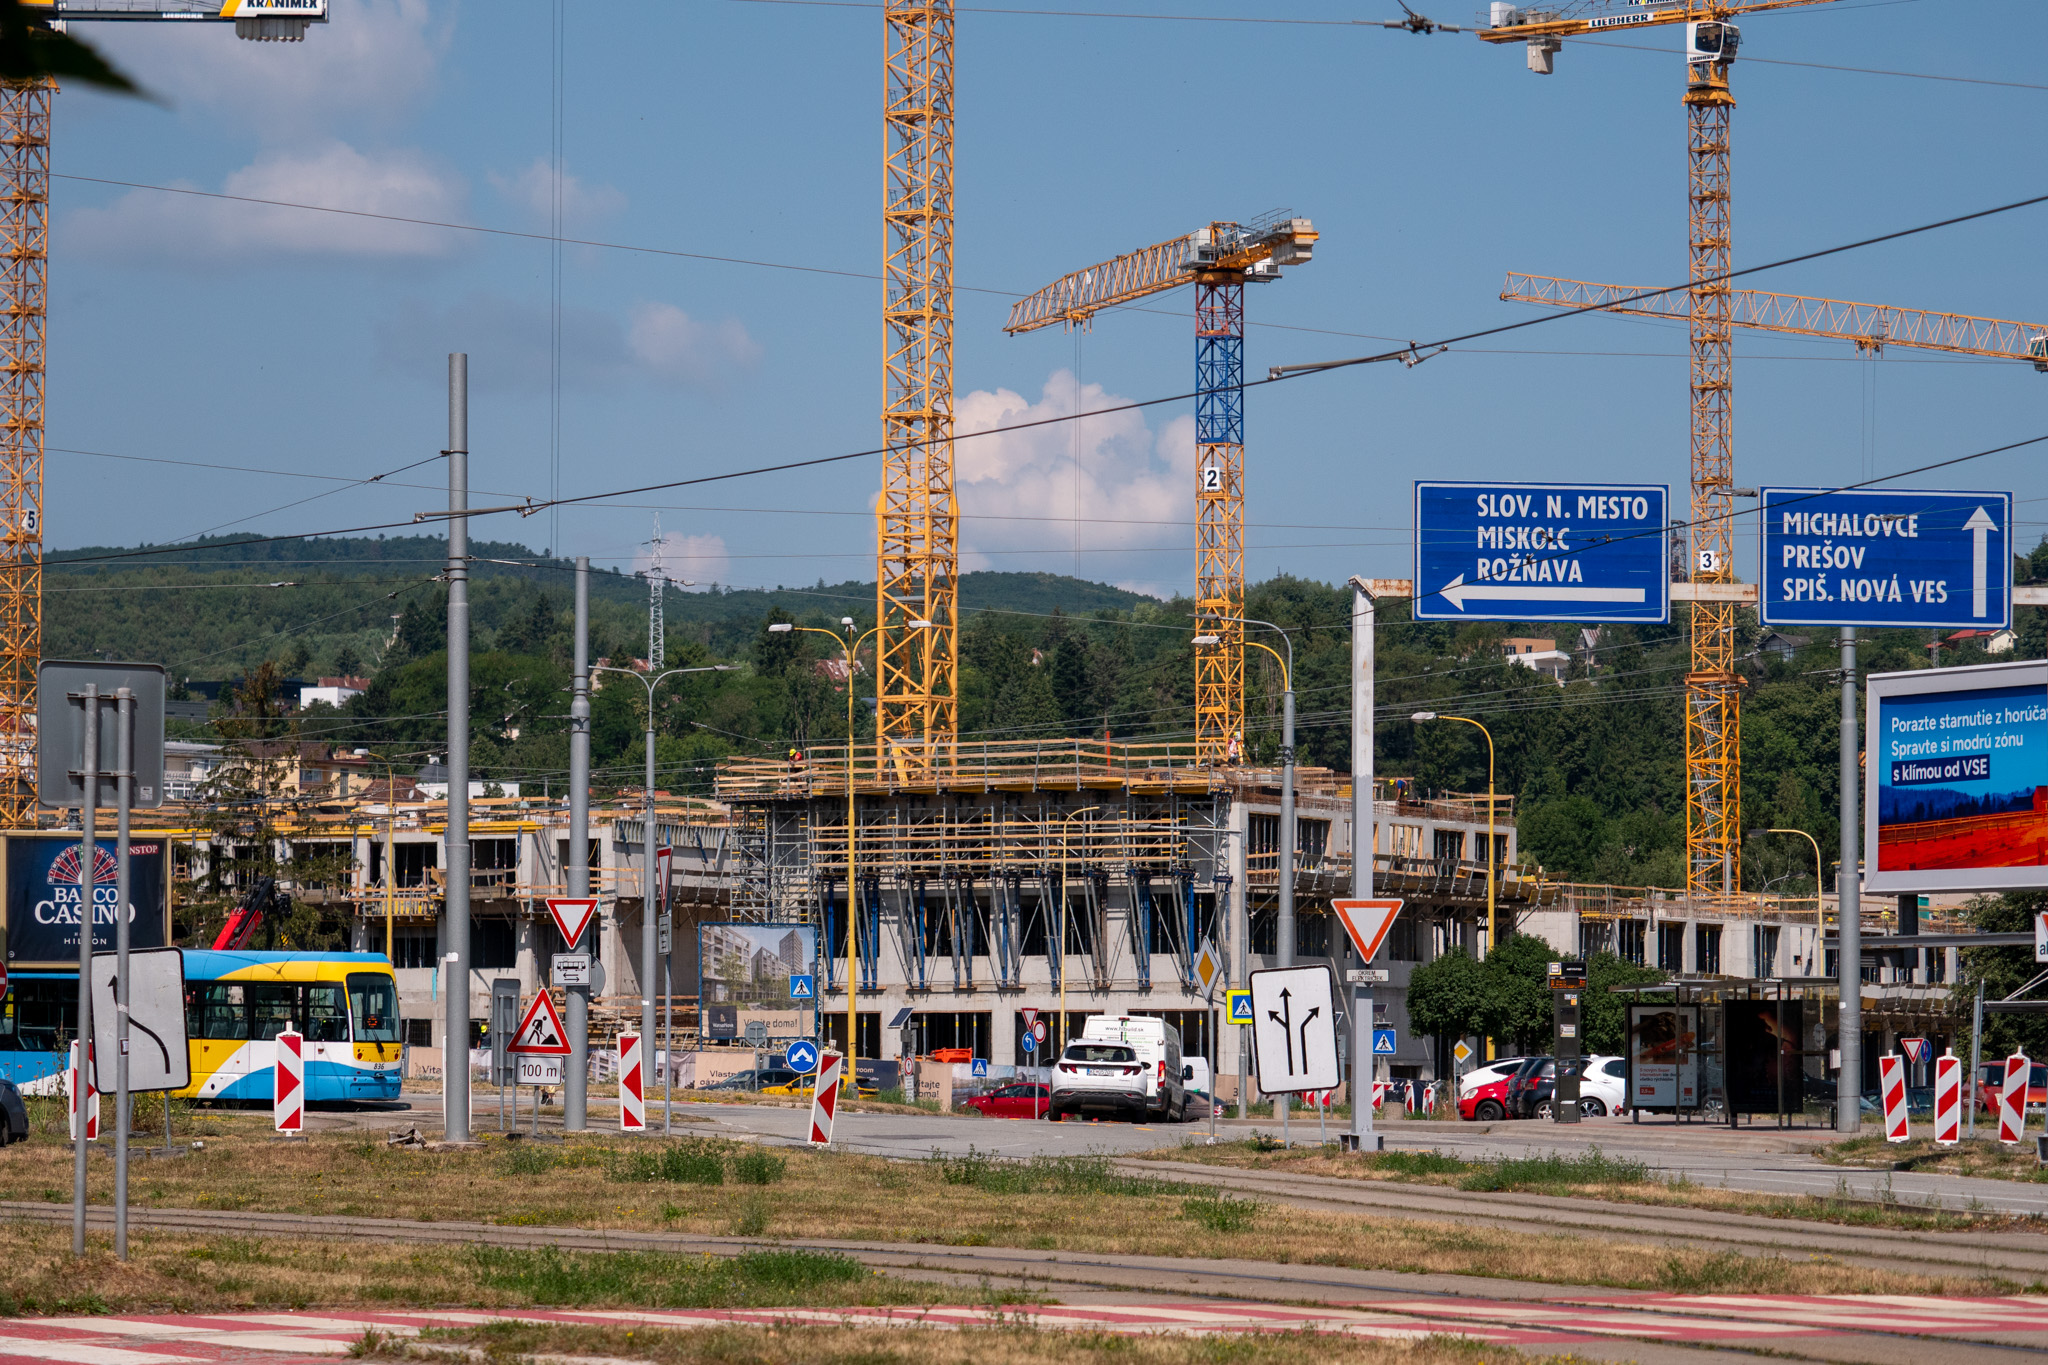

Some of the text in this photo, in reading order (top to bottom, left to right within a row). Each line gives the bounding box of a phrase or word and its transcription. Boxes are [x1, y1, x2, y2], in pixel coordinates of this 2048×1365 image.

[1591, 13, 1649, 27] LIEBHERR
[1207, 470, 1217, 487] 2
[1477, 493, 1648, 520] SLOV. N. MESTO
[28, 511, 35, 529] 5
[1783, 512, 1918, 538] MICHALOVCE
[1477, 526, 1570, 550] MISKOLC
[1702, 553, 1712, 568] 3
[1783, 540, 1866, 569] PREŠOV
[1782, 573, 1948, 603] SPIŠ. NOVÁ VES
[1891, 716, 1937, 733] Porazte
[1939, 709, 1993, 730] starnutie
[1995, 712, 2002, 724] z
[1891, 731, 2024, 760] Spravte si modrú zónu
[1893, 758, 1988, 782] s klímou od VSE
[115, 845, 158, 856] NSTOP
[54, 887, 118, 904] BACO
[772, 1018, 798, 1028] doma!
[373, 1062, 385, 1070] 836
[422, 1065, 443, 1074] Vita
[521, 1064, 557, 1077] 100 m
[709, 1070, 740, 1078] Vlastn
[918, 1090, 939, 1098] oma!
